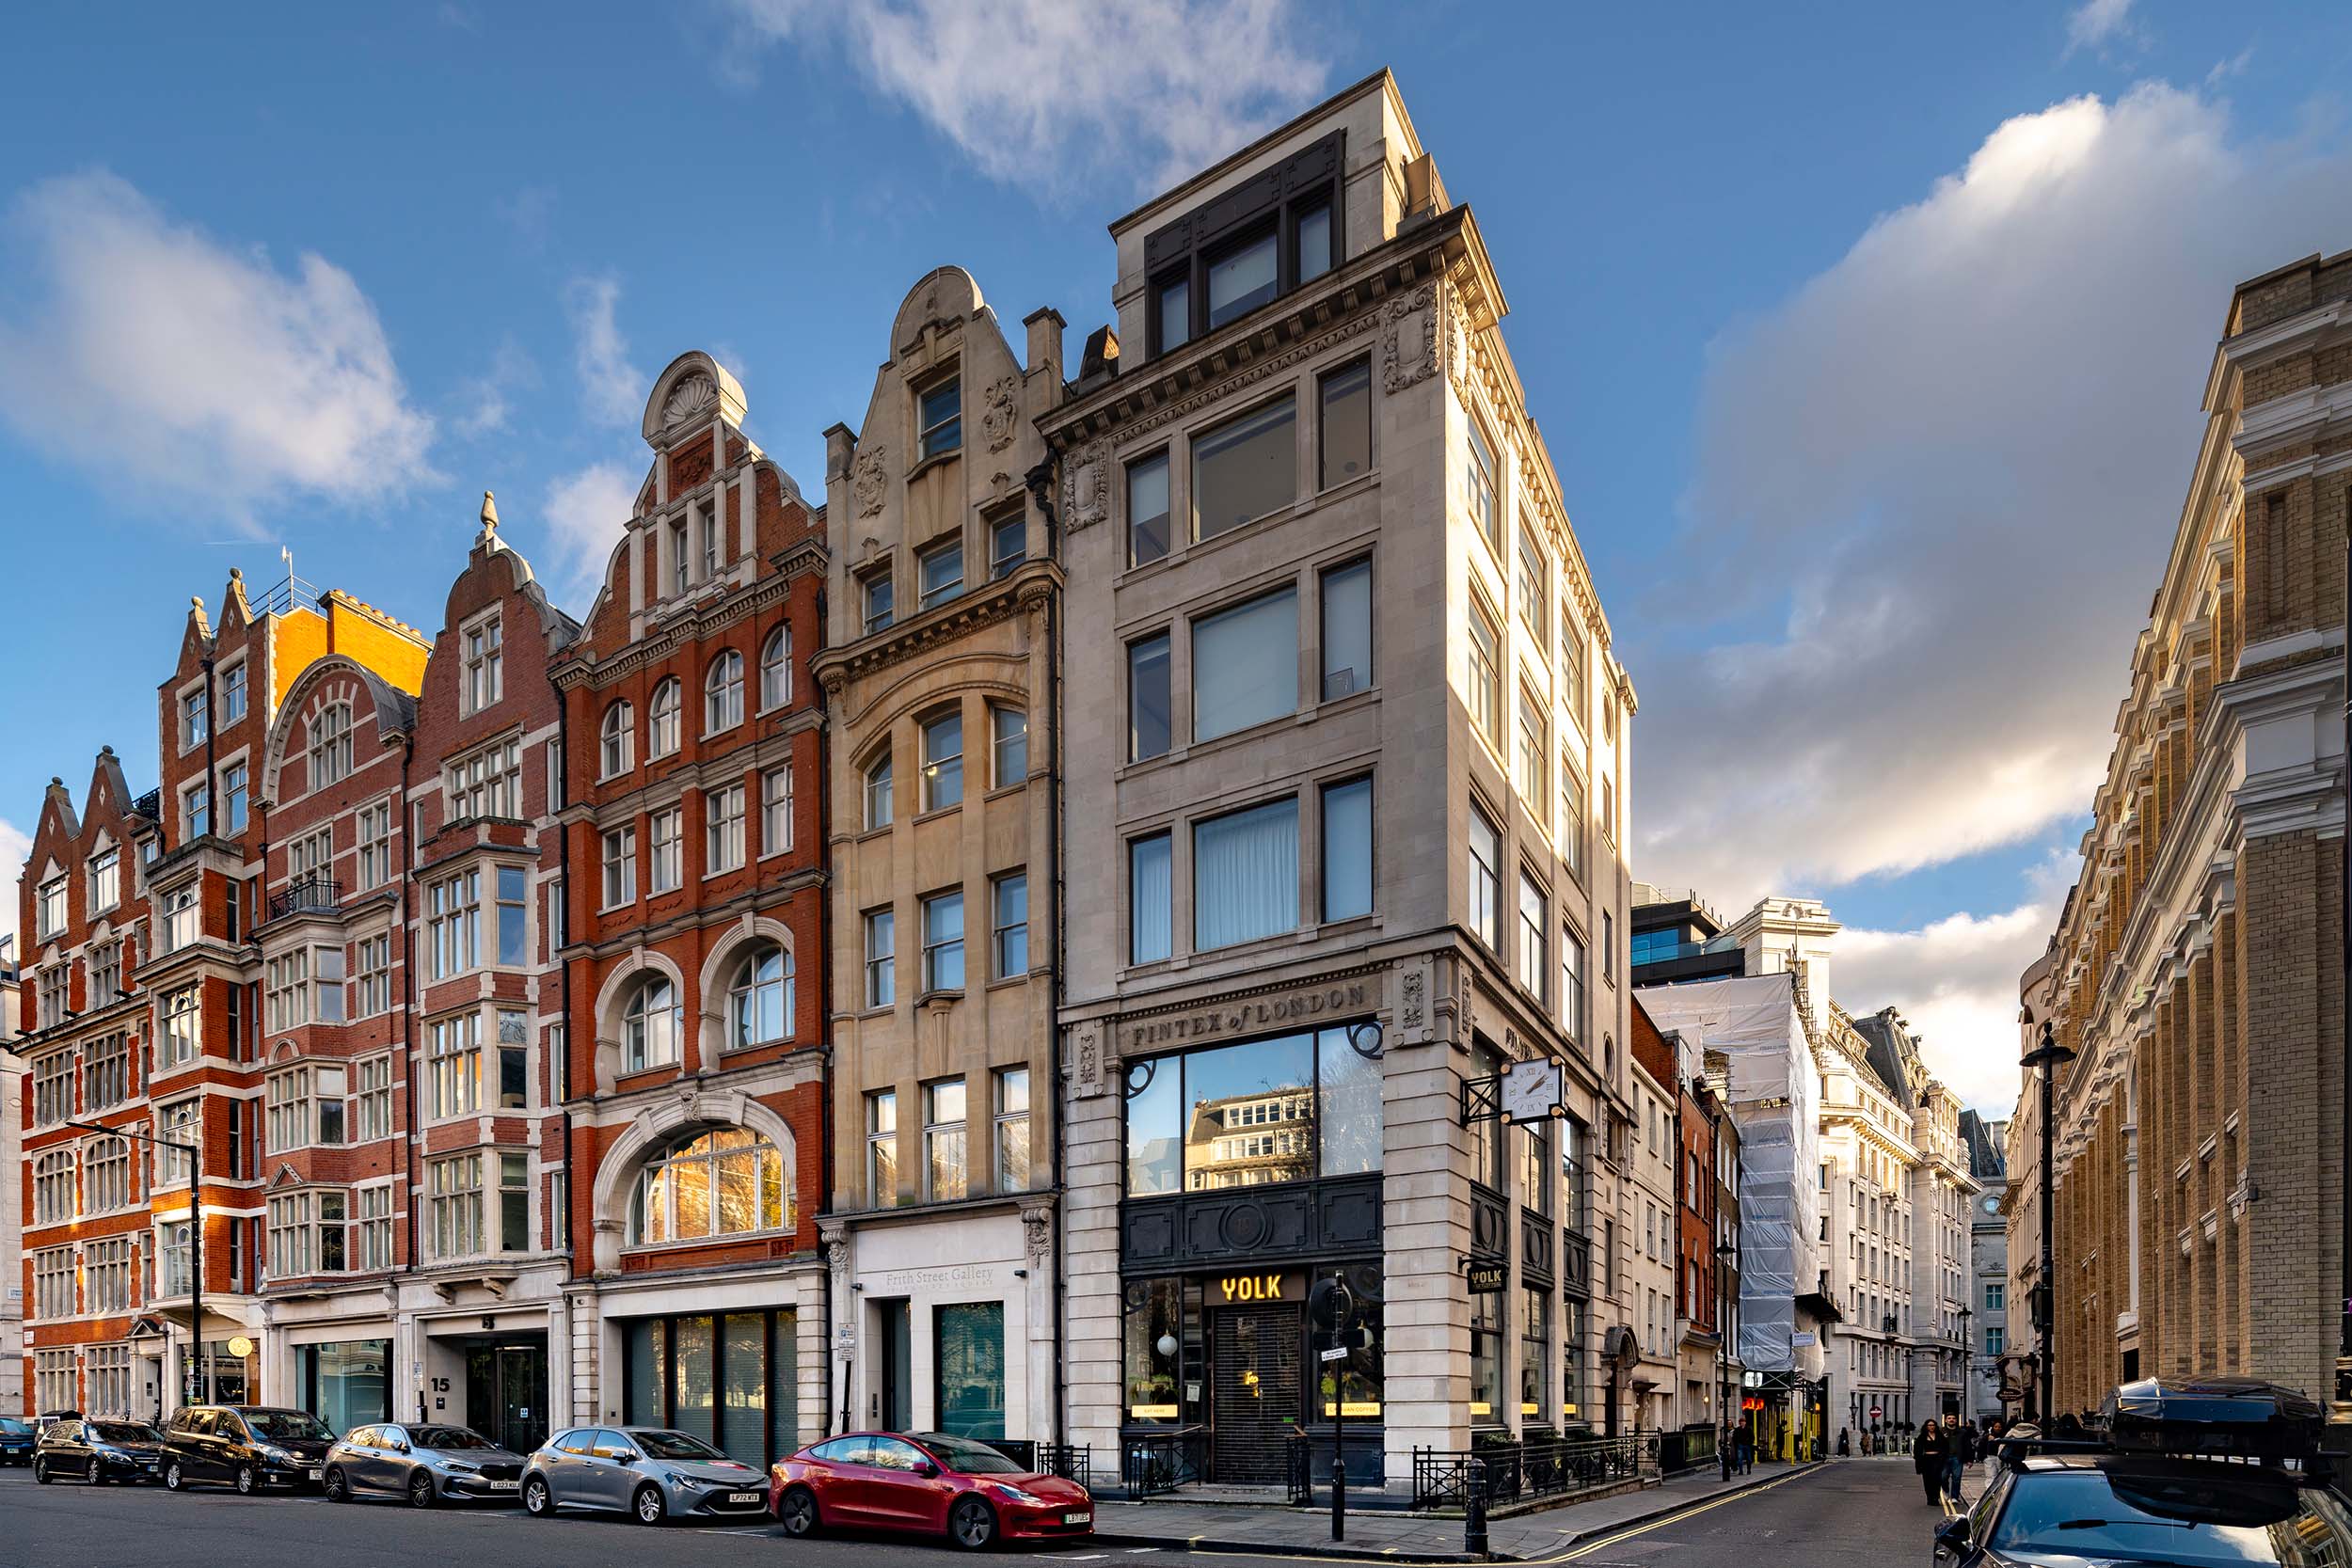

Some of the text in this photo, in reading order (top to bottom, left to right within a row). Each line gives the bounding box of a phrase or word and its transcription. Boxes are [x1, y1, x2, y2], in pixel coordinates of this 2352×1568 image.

[1132, 986, 1364, 1046] FINTEX of LONDON
[886, 1266, 993, 1286] Frith Street Gallery
[1471, 1270, 1502, 1284] YOLK
[1221, 1275, 1281, 1301] YOLK
[431, 1377, 451, 1392] 15
